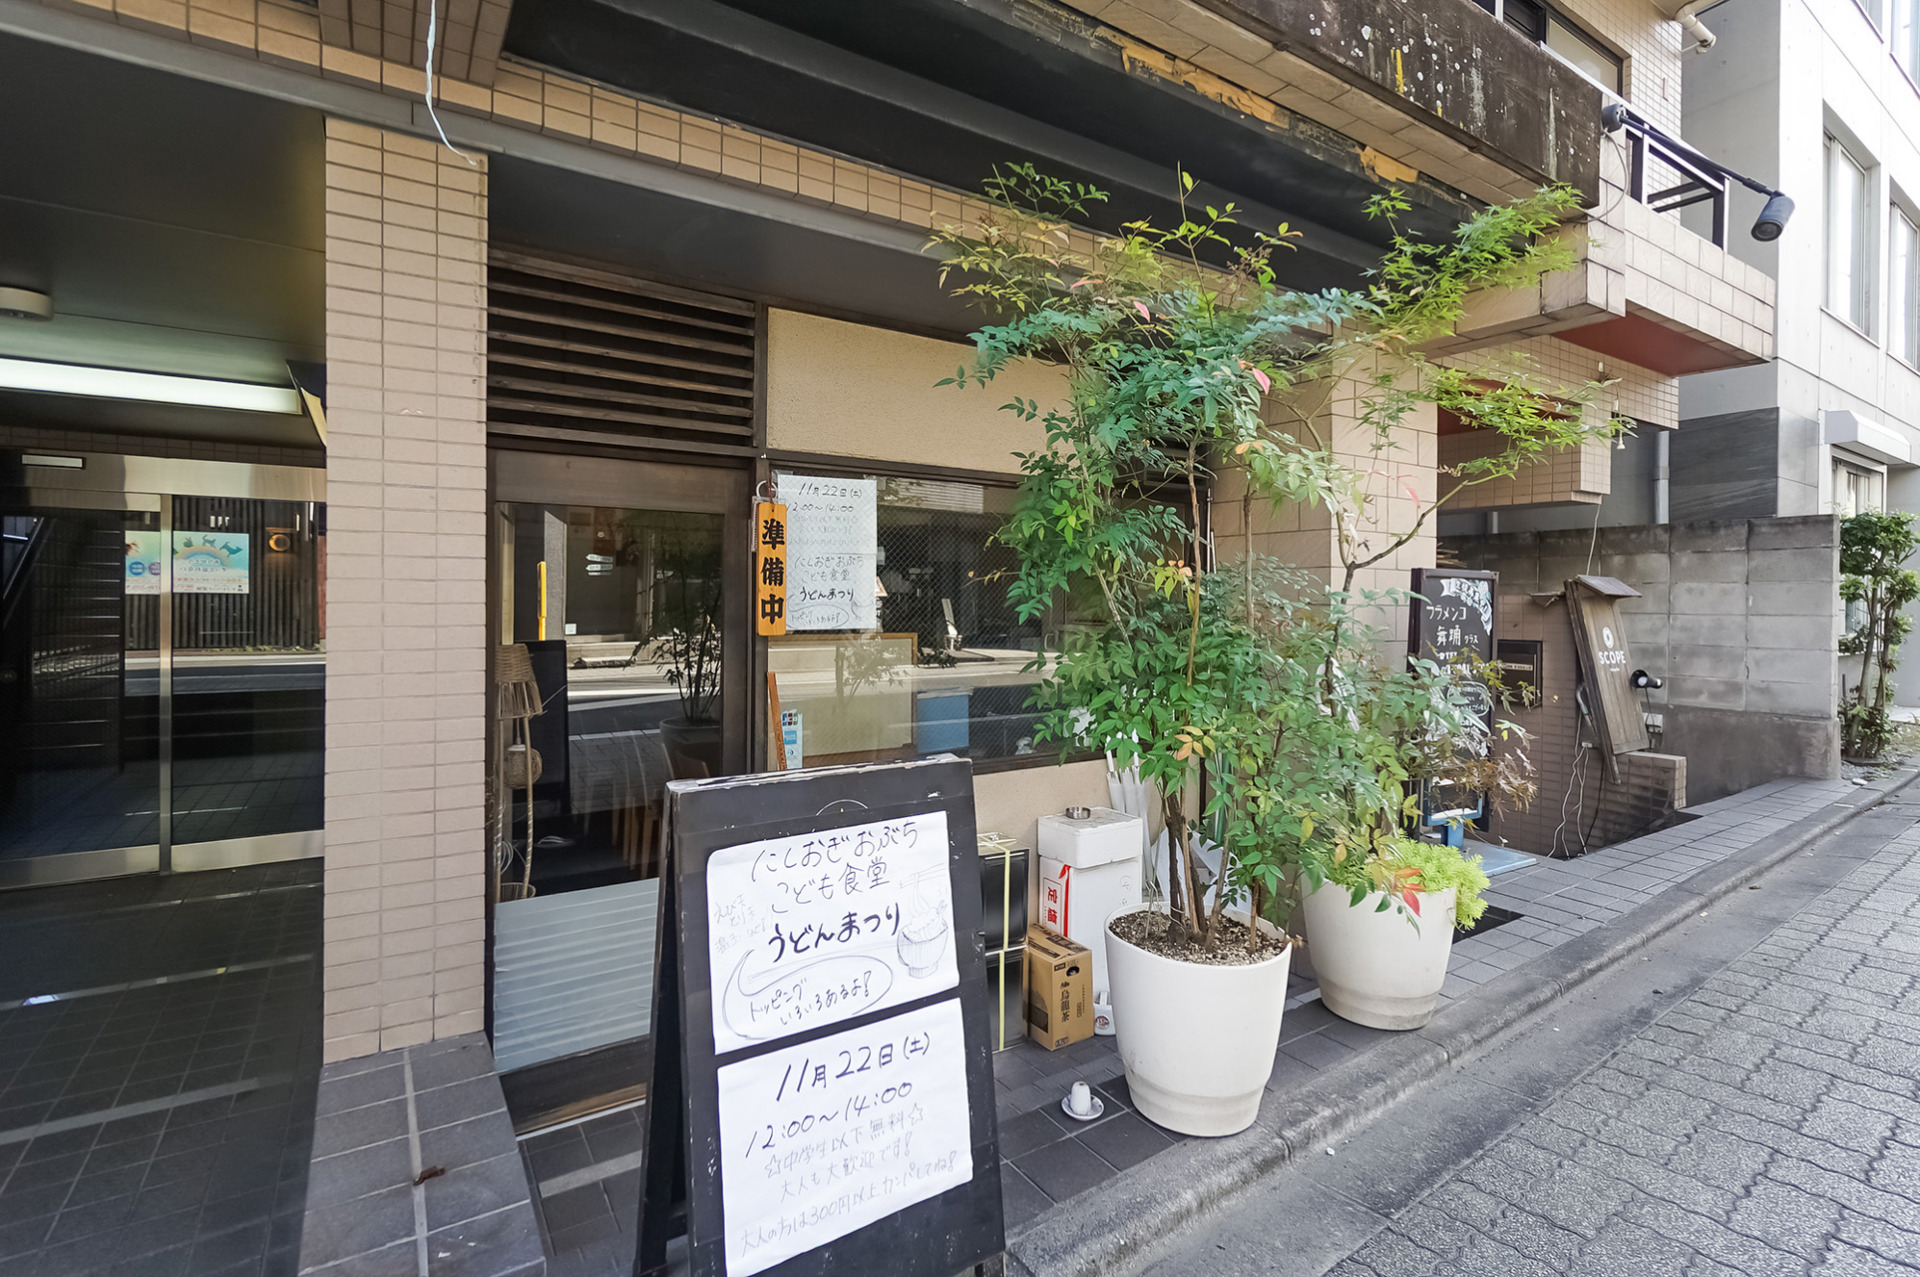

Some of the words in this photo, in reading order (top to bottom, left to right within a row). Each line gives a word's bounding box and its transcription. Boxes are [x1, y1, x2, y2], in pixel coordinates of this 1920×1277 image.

[761, 518, 785, 625] 準備中
[799, 586, 855, 602] うどんまつり
[801, 568, 851, 583] こども食堂
[1426, 604, 1467, 621] フラメンコ
[1436, 625, 1461, 647] 舞踊
[1464, 634, 1479, 644] クラス
[1598, 650, 1626, 665] SCOPE
[752, 821, 918, 882] にしおぎおぶち
[771, 856, 890, 913] こども食堂
[768, 902, 900, 963] うどんまつり
[750, 978, 807, 1021] トッピング
[776, 1032, 931, 1101] 11月22日(土)
[745, 1081, 913, 1159] 12:00~14:00
